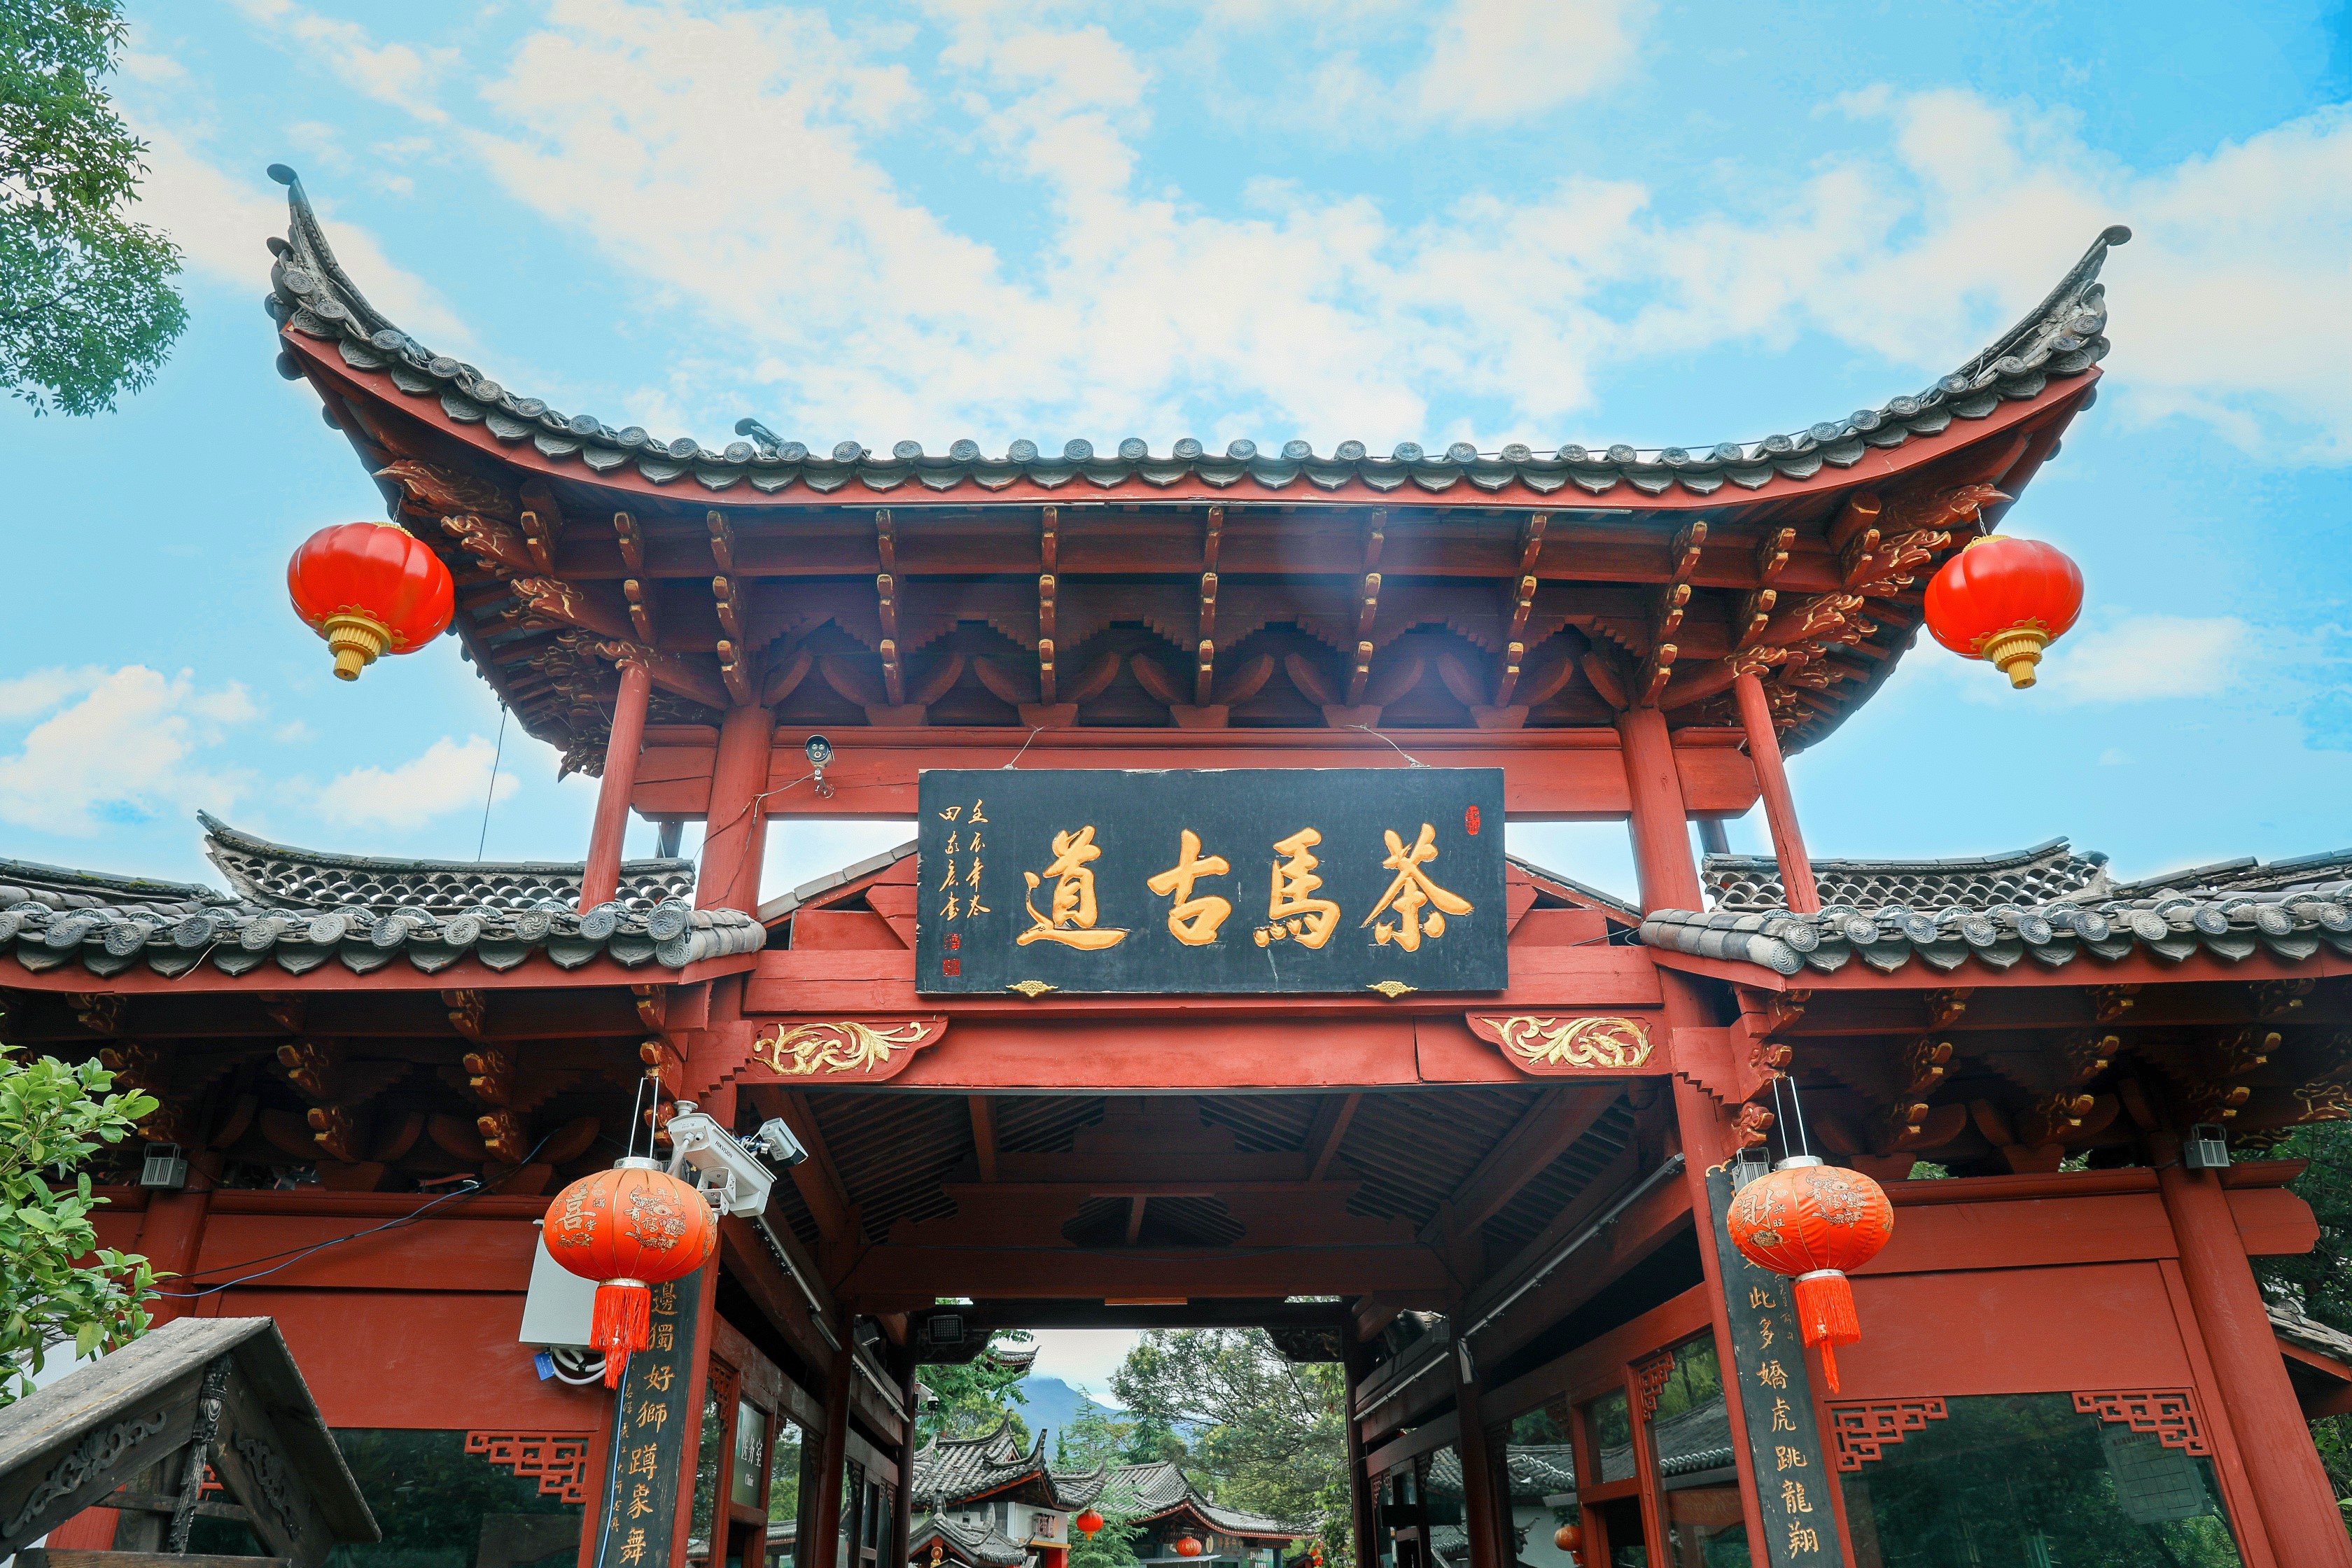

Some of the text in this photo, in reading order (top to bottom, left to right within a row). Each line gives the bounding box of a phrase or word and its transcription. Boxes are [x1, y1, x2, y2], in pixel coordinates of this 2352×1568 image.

[715, 1140, 734, 1158] HIKVISION
[554, 1187, 597, 1231] 喜
[741, 1432, 763, 1467] 医务室
